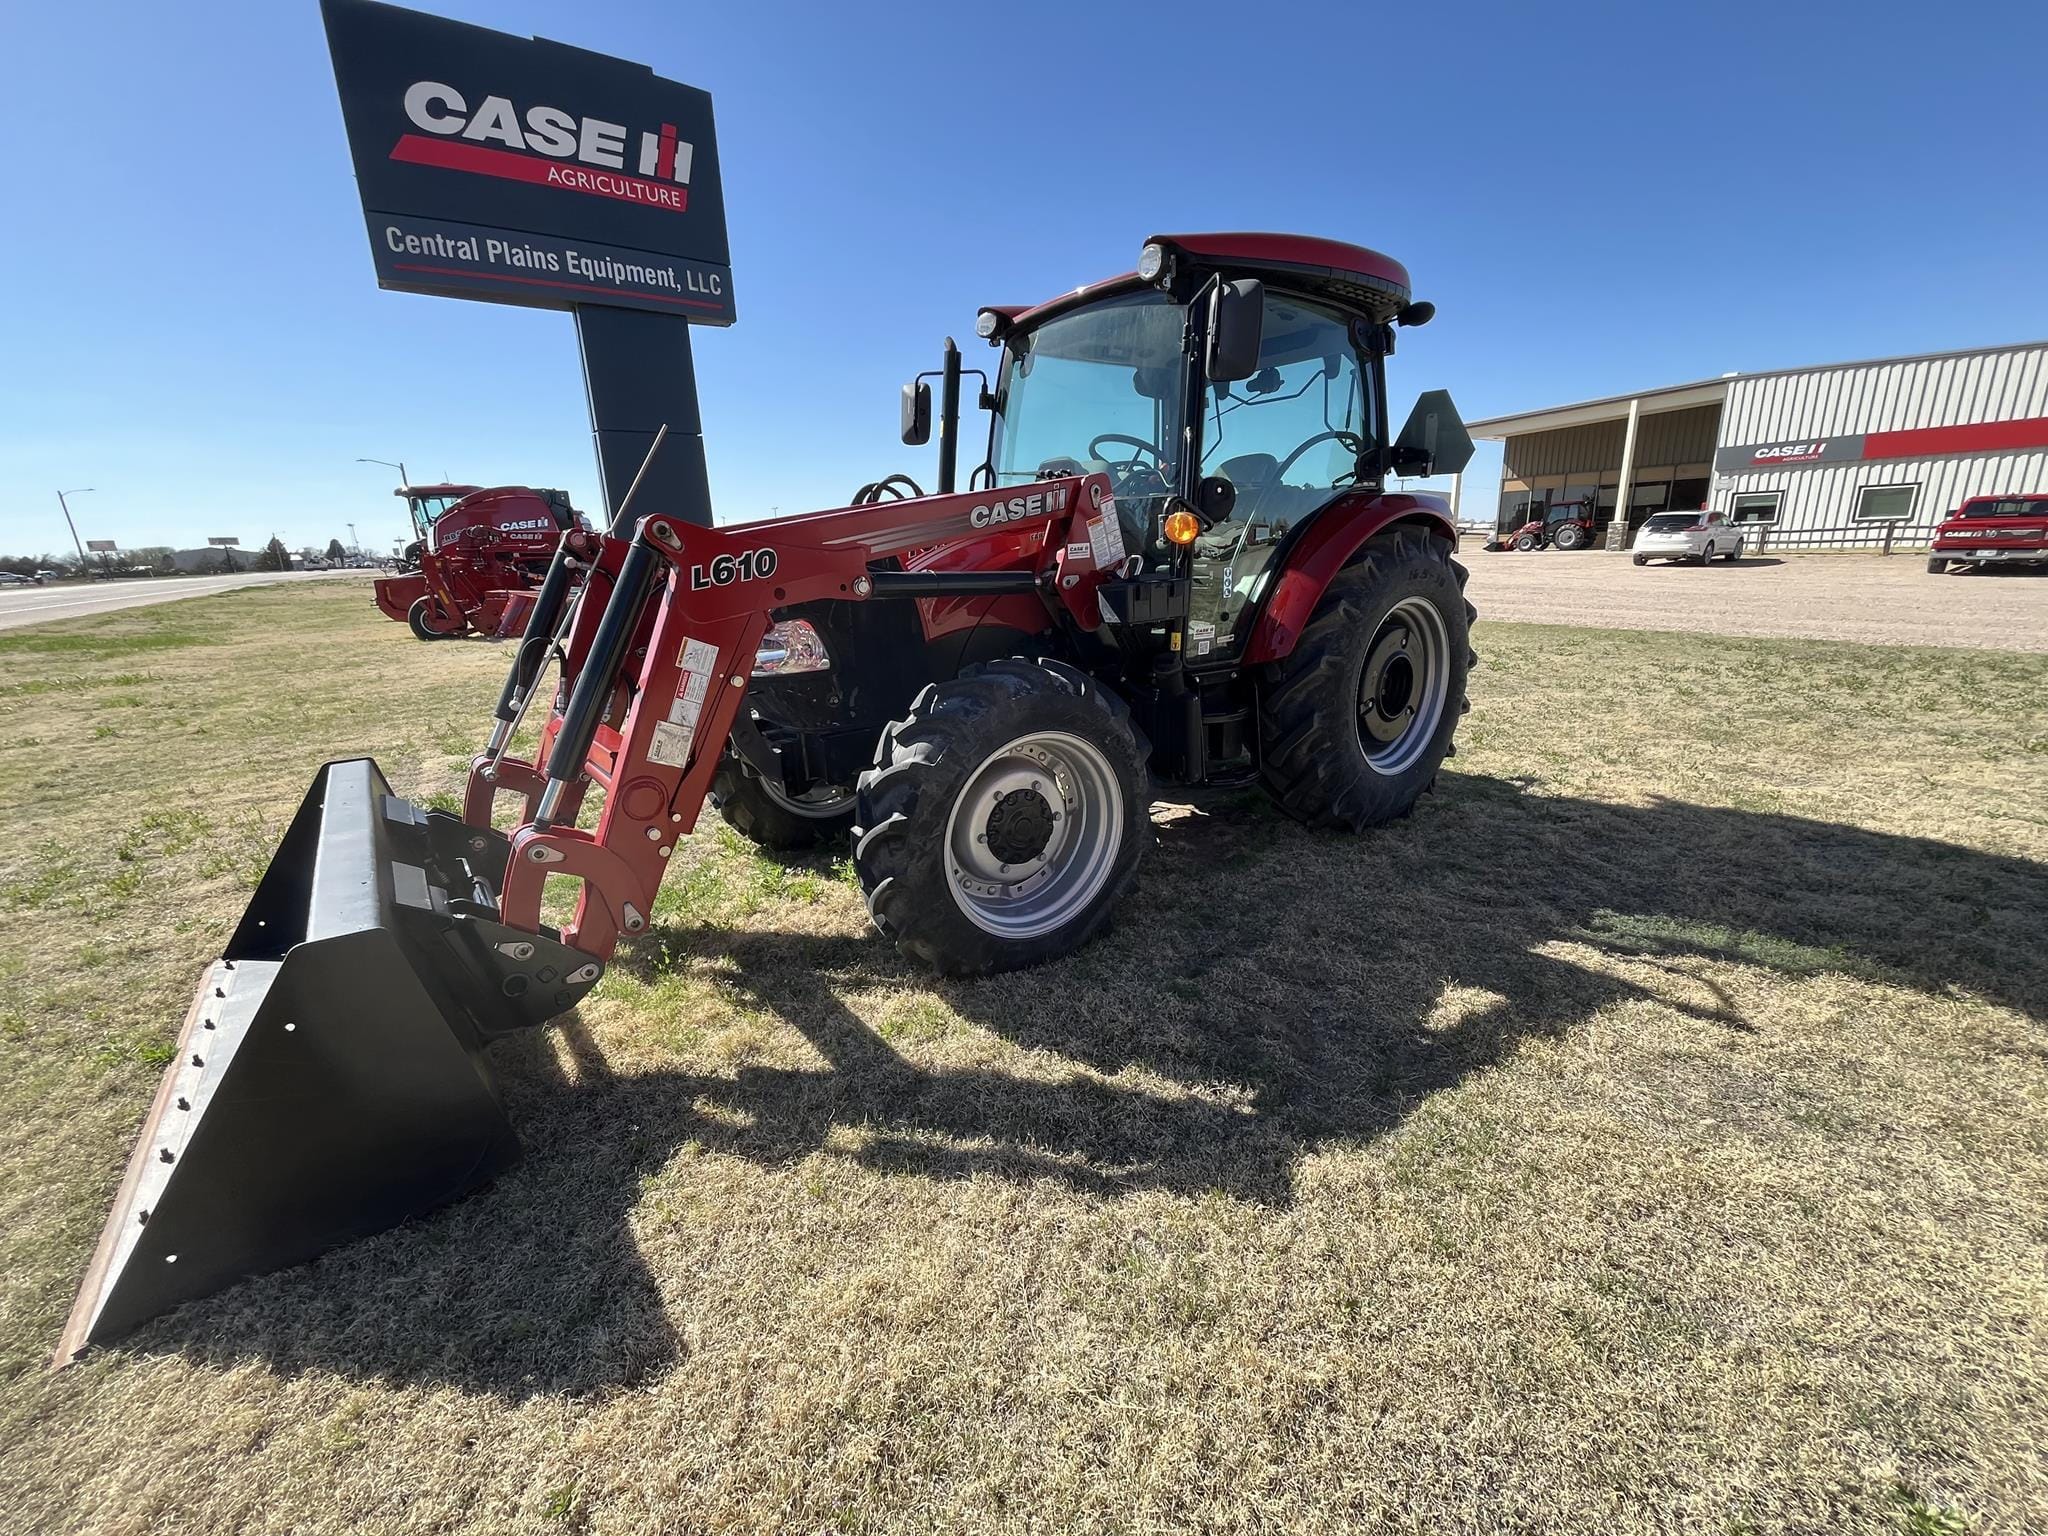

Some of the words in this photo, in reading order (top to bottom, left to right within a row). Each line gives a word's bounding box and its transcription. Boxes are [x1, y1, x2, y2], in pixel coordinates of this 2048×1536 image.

[404, 81, 627, 169] CASE
[547, 166, 681, 208] AGRICULTURE
[385, 225, 480, 263] Central
[488, 239, 560, 272] Plains
[567, 250, 682, 293] Equipment,
[686, 271, 722, 296] LLC
[1754, 444, 1808, 459] CASE
[500, 520, 536, 532] CASE
[970, 493, 1042, 529] CASE
[691, 548, 778, 591] L610
